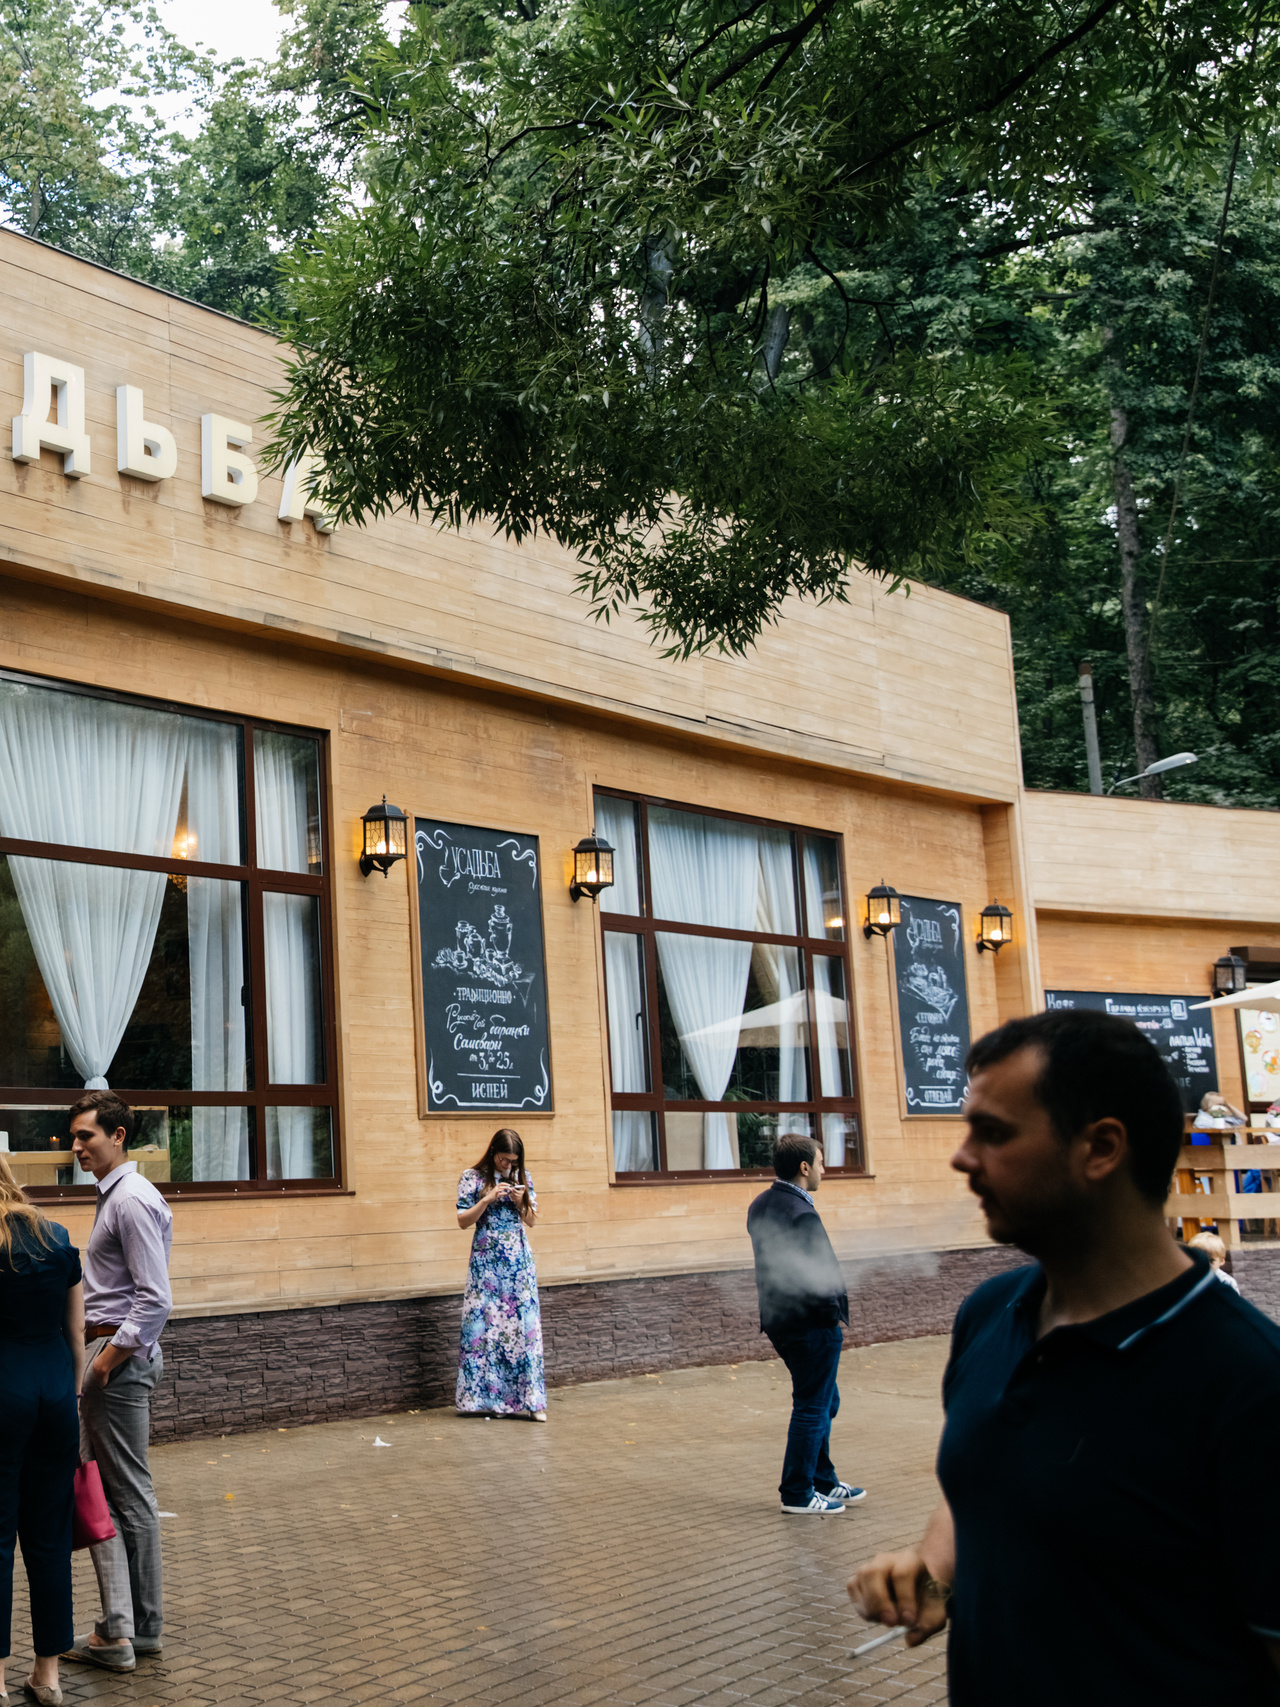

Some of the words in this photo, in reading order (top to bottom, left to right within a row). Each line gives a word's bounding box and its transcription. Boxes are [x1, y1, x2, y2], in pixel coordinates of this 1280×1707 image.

[451, 846, 501, 880] УСАДЬБА
[457, 987, 512, 1004] ТРАДИЦИОННО
[472, 1079, 508, 1099] ИСПЕЙ
